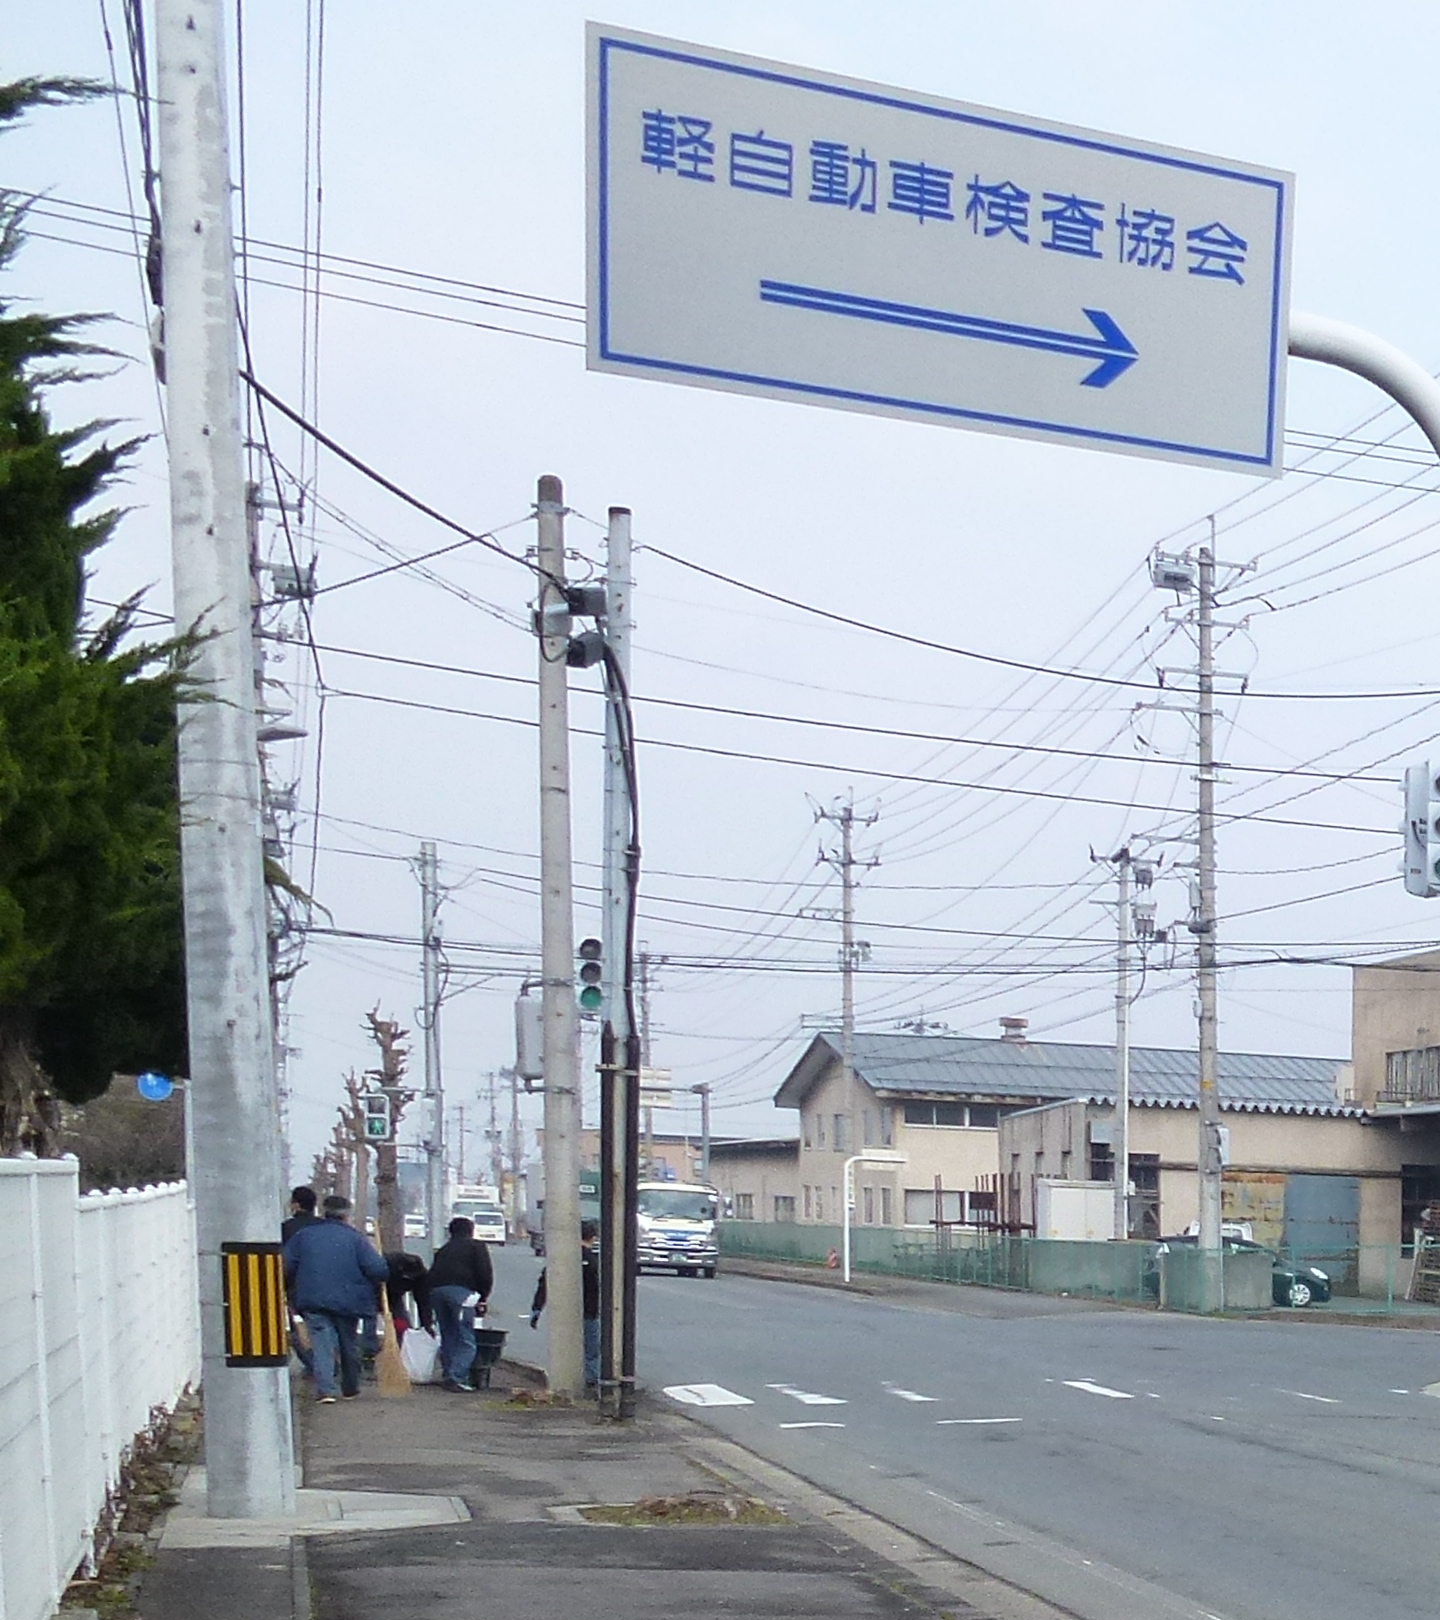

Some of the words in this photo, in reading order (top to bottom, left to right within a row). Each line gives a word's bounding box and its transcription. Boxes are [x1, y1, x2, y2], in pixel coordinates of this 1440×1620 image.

[640, 108, 1248, 286] 軽自動車検査協会
